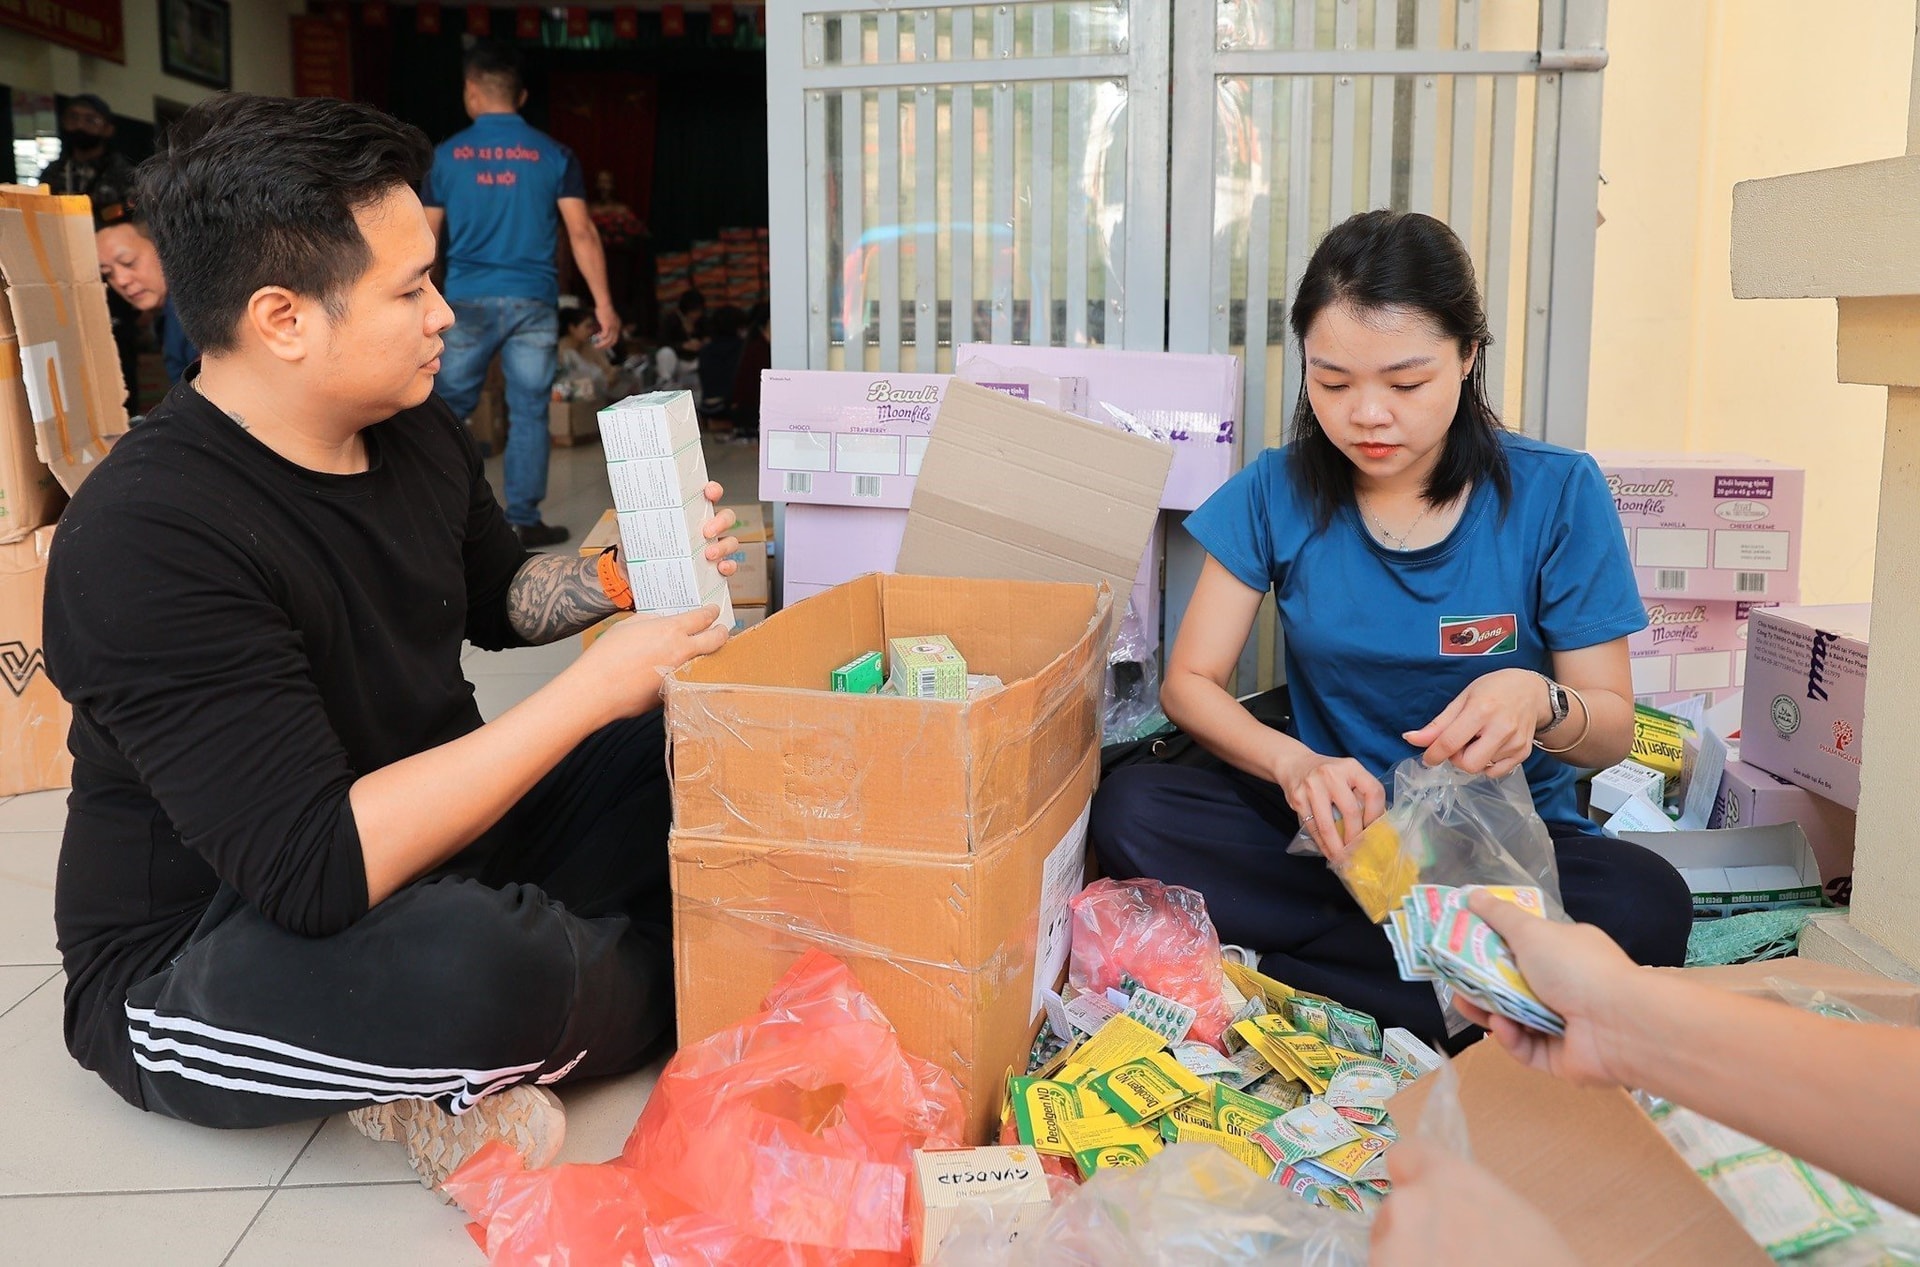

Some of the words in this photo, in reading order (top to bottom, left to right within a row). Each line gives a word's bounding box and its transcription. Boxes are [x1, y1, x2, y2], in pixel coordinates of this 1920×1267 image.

[866, 380, 940, 404] Bauli
[877, 405, 932, 425] Moonfils
[788, 424, 811, 432] CHOCO
[849, 426, 887, 434] STRAWBERRY
[1605, 474, 1676, 498] Bauli
[1660, 521, 1686, 529] VANILLA
[1729, 522, 1752, 530] CHEESE
[1648, 604, 1707, 626] Bauli
[1652, 625, 1699, 645] Moonfils
[1115, 1072, 1128, 1085] ND
[1037, 1087, 1049, 1099] ND
[1126, 1080, 1160, 1109] Decolgen
[1041, 1096, 1059, 1144] Decolgen
[1173, 1110, 1190, 1124] ND
[1226, 1123, 1242, 1137] ND
